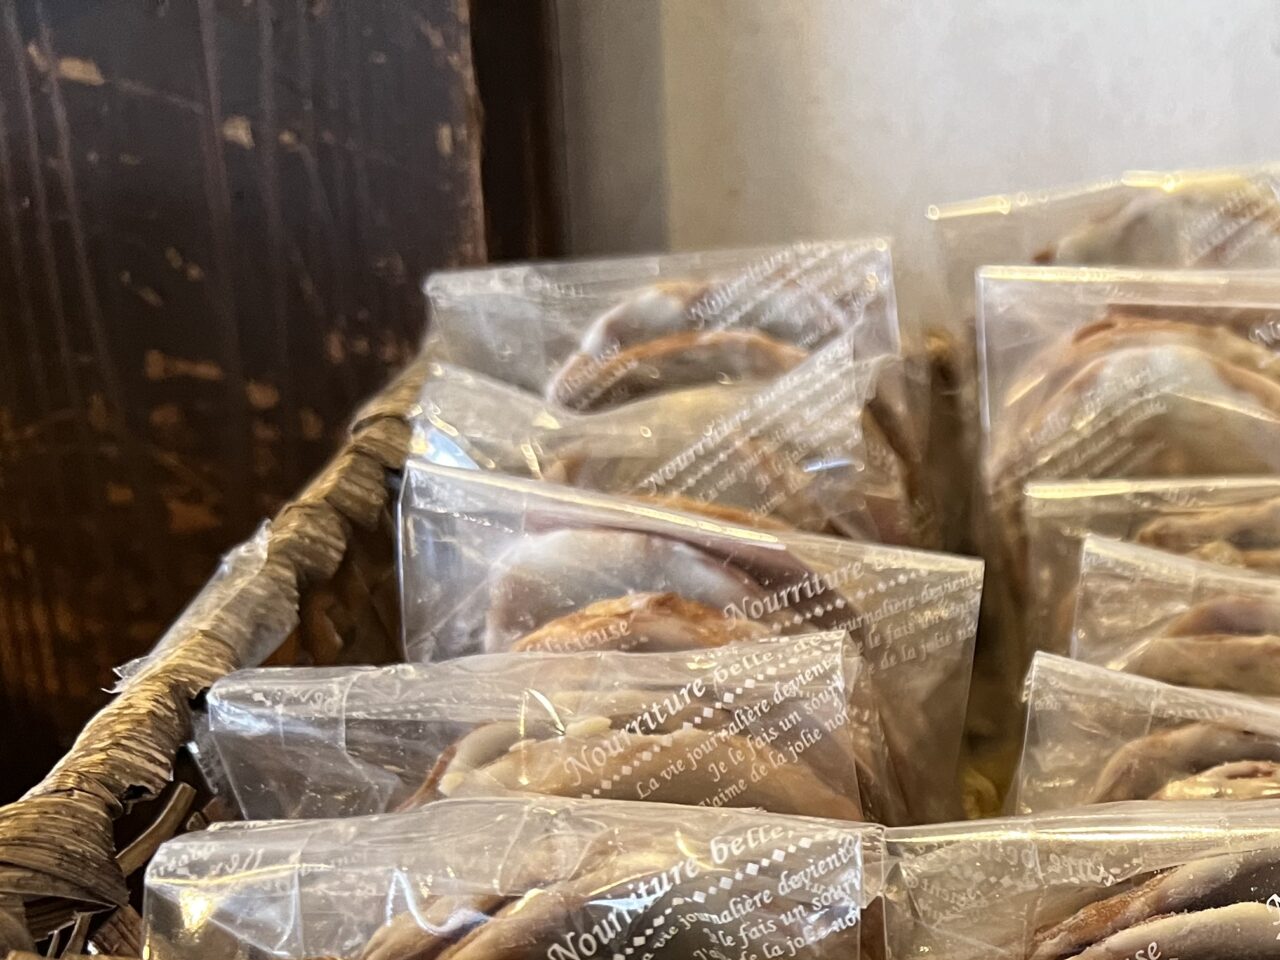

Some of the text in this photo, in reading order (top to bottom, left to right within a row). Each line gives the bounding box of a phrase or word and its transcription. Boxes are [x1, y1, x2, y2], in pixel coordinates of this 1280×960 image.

[722, 560, 864, 630] Nourriture
[563, 651, 783, 787] Nourriture belle,
[708, 760, 728, 783] Je
[728, 747, 745, 766] le
[746, 727, 779, 761] fais
[778, 710, 802, 733] un
[635, 778, 660, 800] La
[660, 758, 686, 781] vie
[687, 699, 771, 772] journalière
[750, 764, 768, 784] de
[768, 750, 787, 769] la
[788, 728, 822, 763] jolie
[710, 824, 795, 865] belle,
[653, 923, 680, 950] vie
[739, 919, 778, 949] fais
[780, 904, 807, 926] un
[763, 942, 785, 959] la
